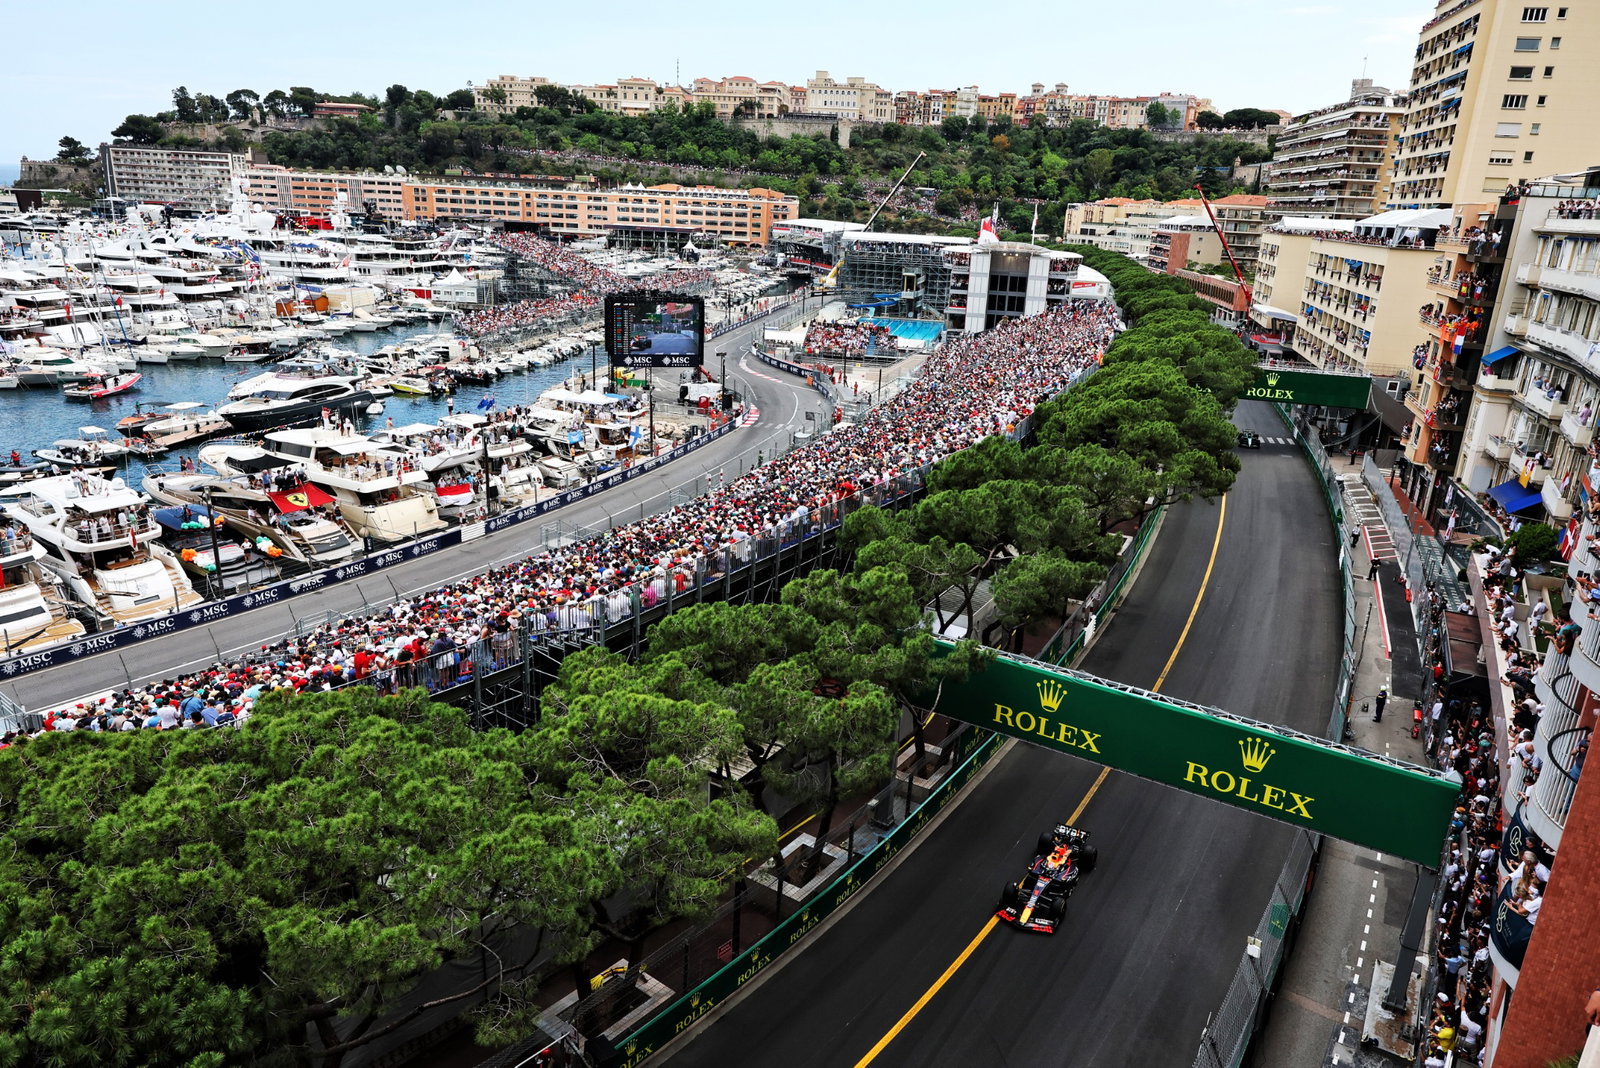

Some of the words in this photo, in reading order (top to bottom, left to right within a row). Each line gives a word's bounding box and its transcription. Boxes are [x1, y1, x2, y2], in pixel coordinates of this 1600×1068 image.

[1246, 387, 1294, 400] ROLEX
[548, 498, 560, 508] MSC
[523, 506, 537, 516] MSC
[496, 516, 511, 526] MSC
[420, 540, 438, 551] MSC
[385, 550, 403, 562] MSC
[345, 562, 366, 574] MSC
[254, 588, 278, 602] MSC
[203, 602, 228, 618] MSC
[147, 618, 175, 633] MSC
[86, 634, 116, 650] MSC
[20, 652, 52, 668] MSC
[992, 704, 1102, 754] ROLEX
[1184, 761, 1315, 819] ROLEX
[836, 878, 861, 906] ROLEX
[790, 914, 820, 944] ROLEX
[737, 952, 772, 986] ROLEX
[674, 997, 715, 1034] ROLEX
